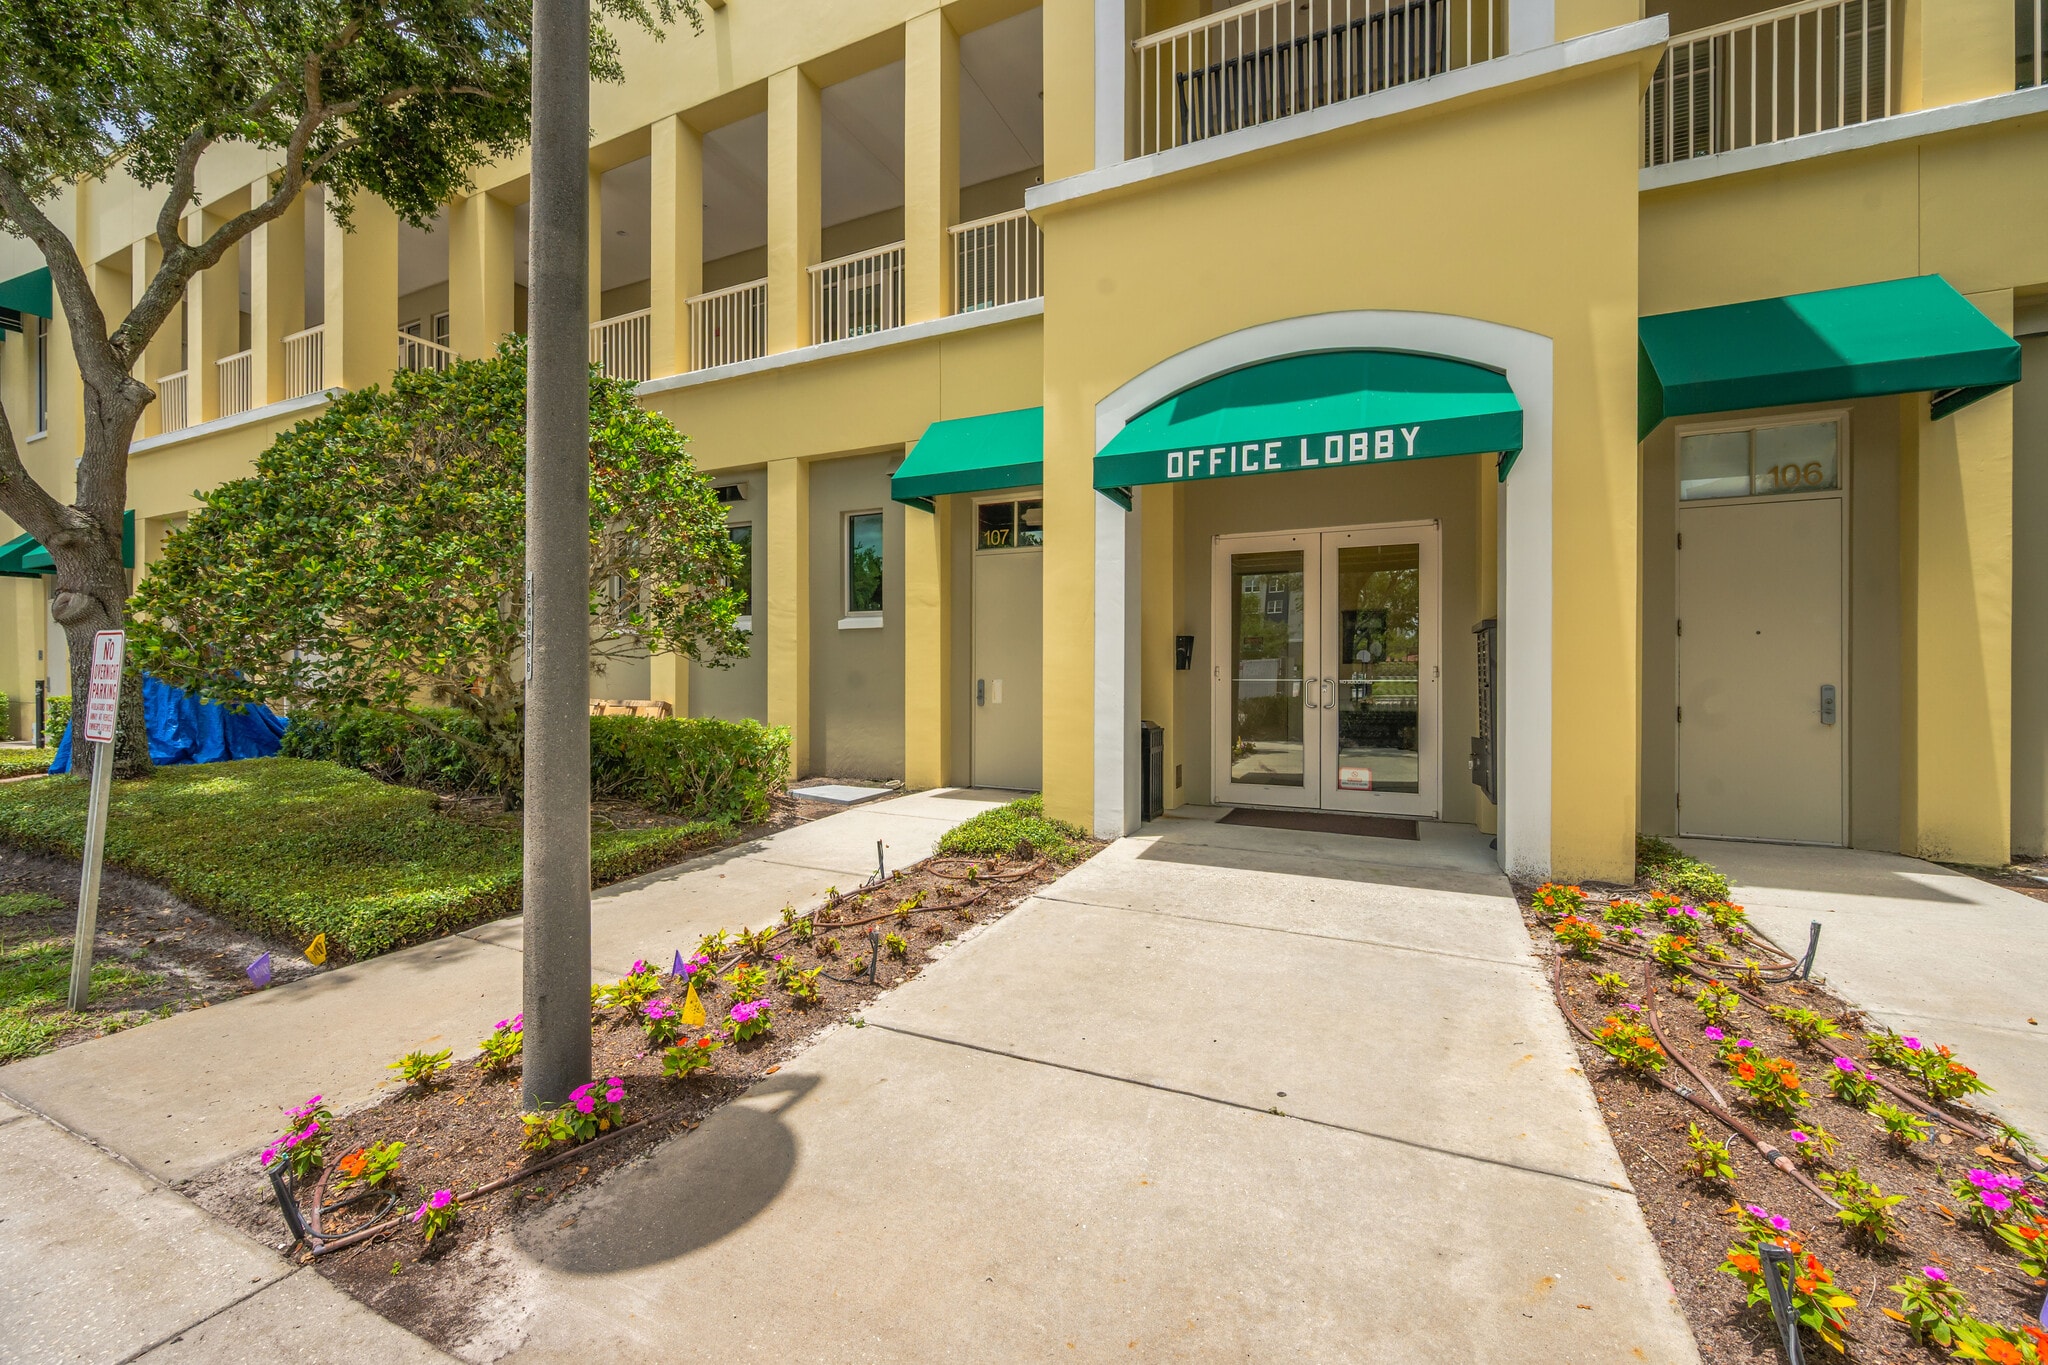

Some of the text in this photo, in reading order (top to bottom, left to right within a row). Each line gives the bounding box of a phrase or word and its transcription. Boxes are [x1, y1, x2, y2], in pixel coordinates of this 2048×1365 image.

[1167, 426, 1420, 478] OFFICE LOBBY
[1767, 461, 1823, 488] 106
[984, 528, 1010, 546] 107
[103, 641, 114, 660] NO
[94, 663, 118, 679] OVERNIGHT
[91, 683, 116, 699] PARKING
